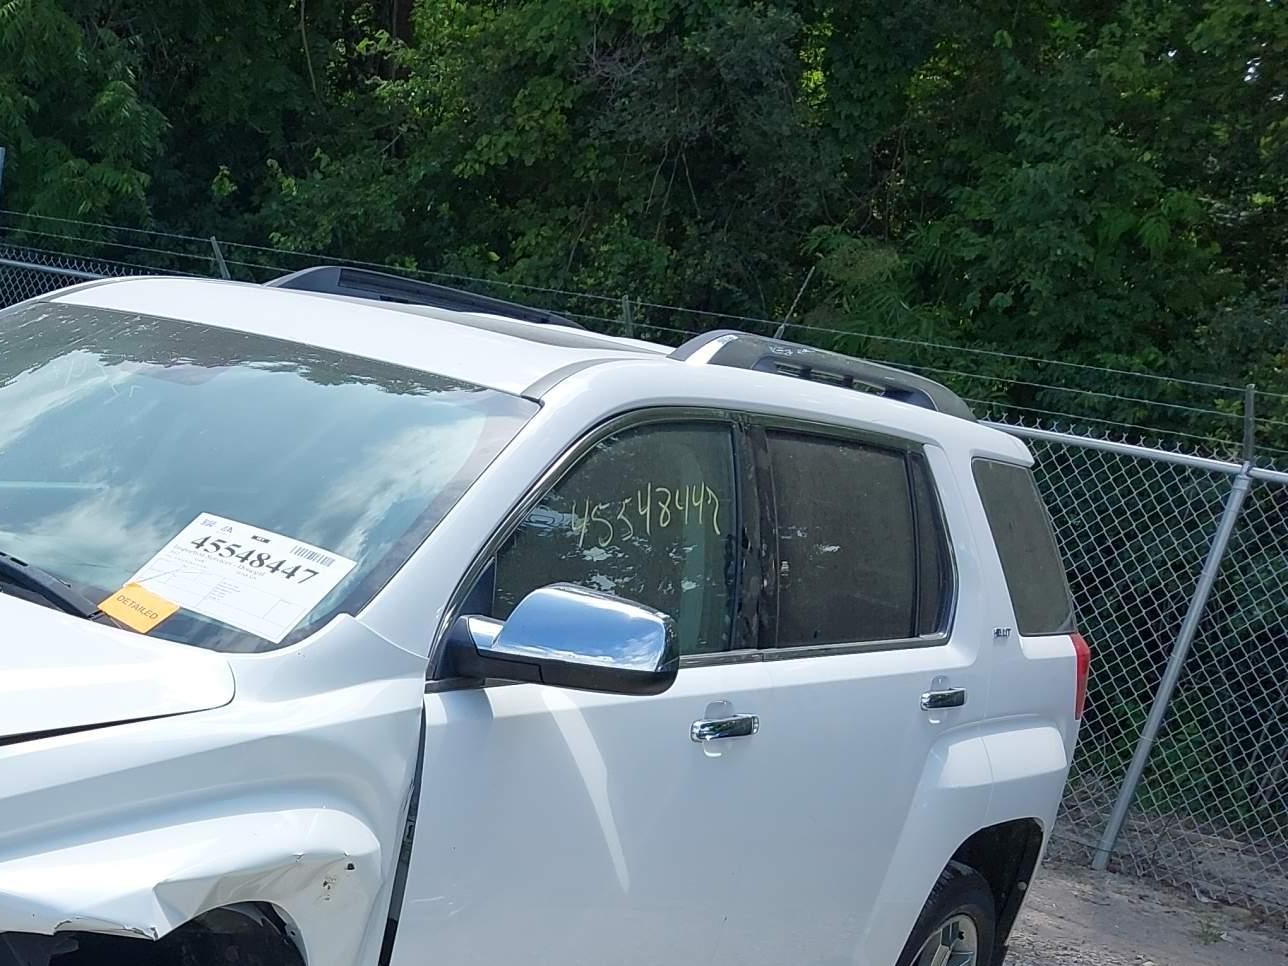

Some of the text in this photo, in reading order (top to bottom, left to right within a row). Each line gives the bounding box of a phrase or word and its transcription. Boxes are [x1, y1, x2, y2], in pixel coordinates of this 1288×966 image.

[571, 481, 721, 549] 45548447
[191, 535, 320, 584] 45548447
[116, 594, 159, 620] DETAILED
